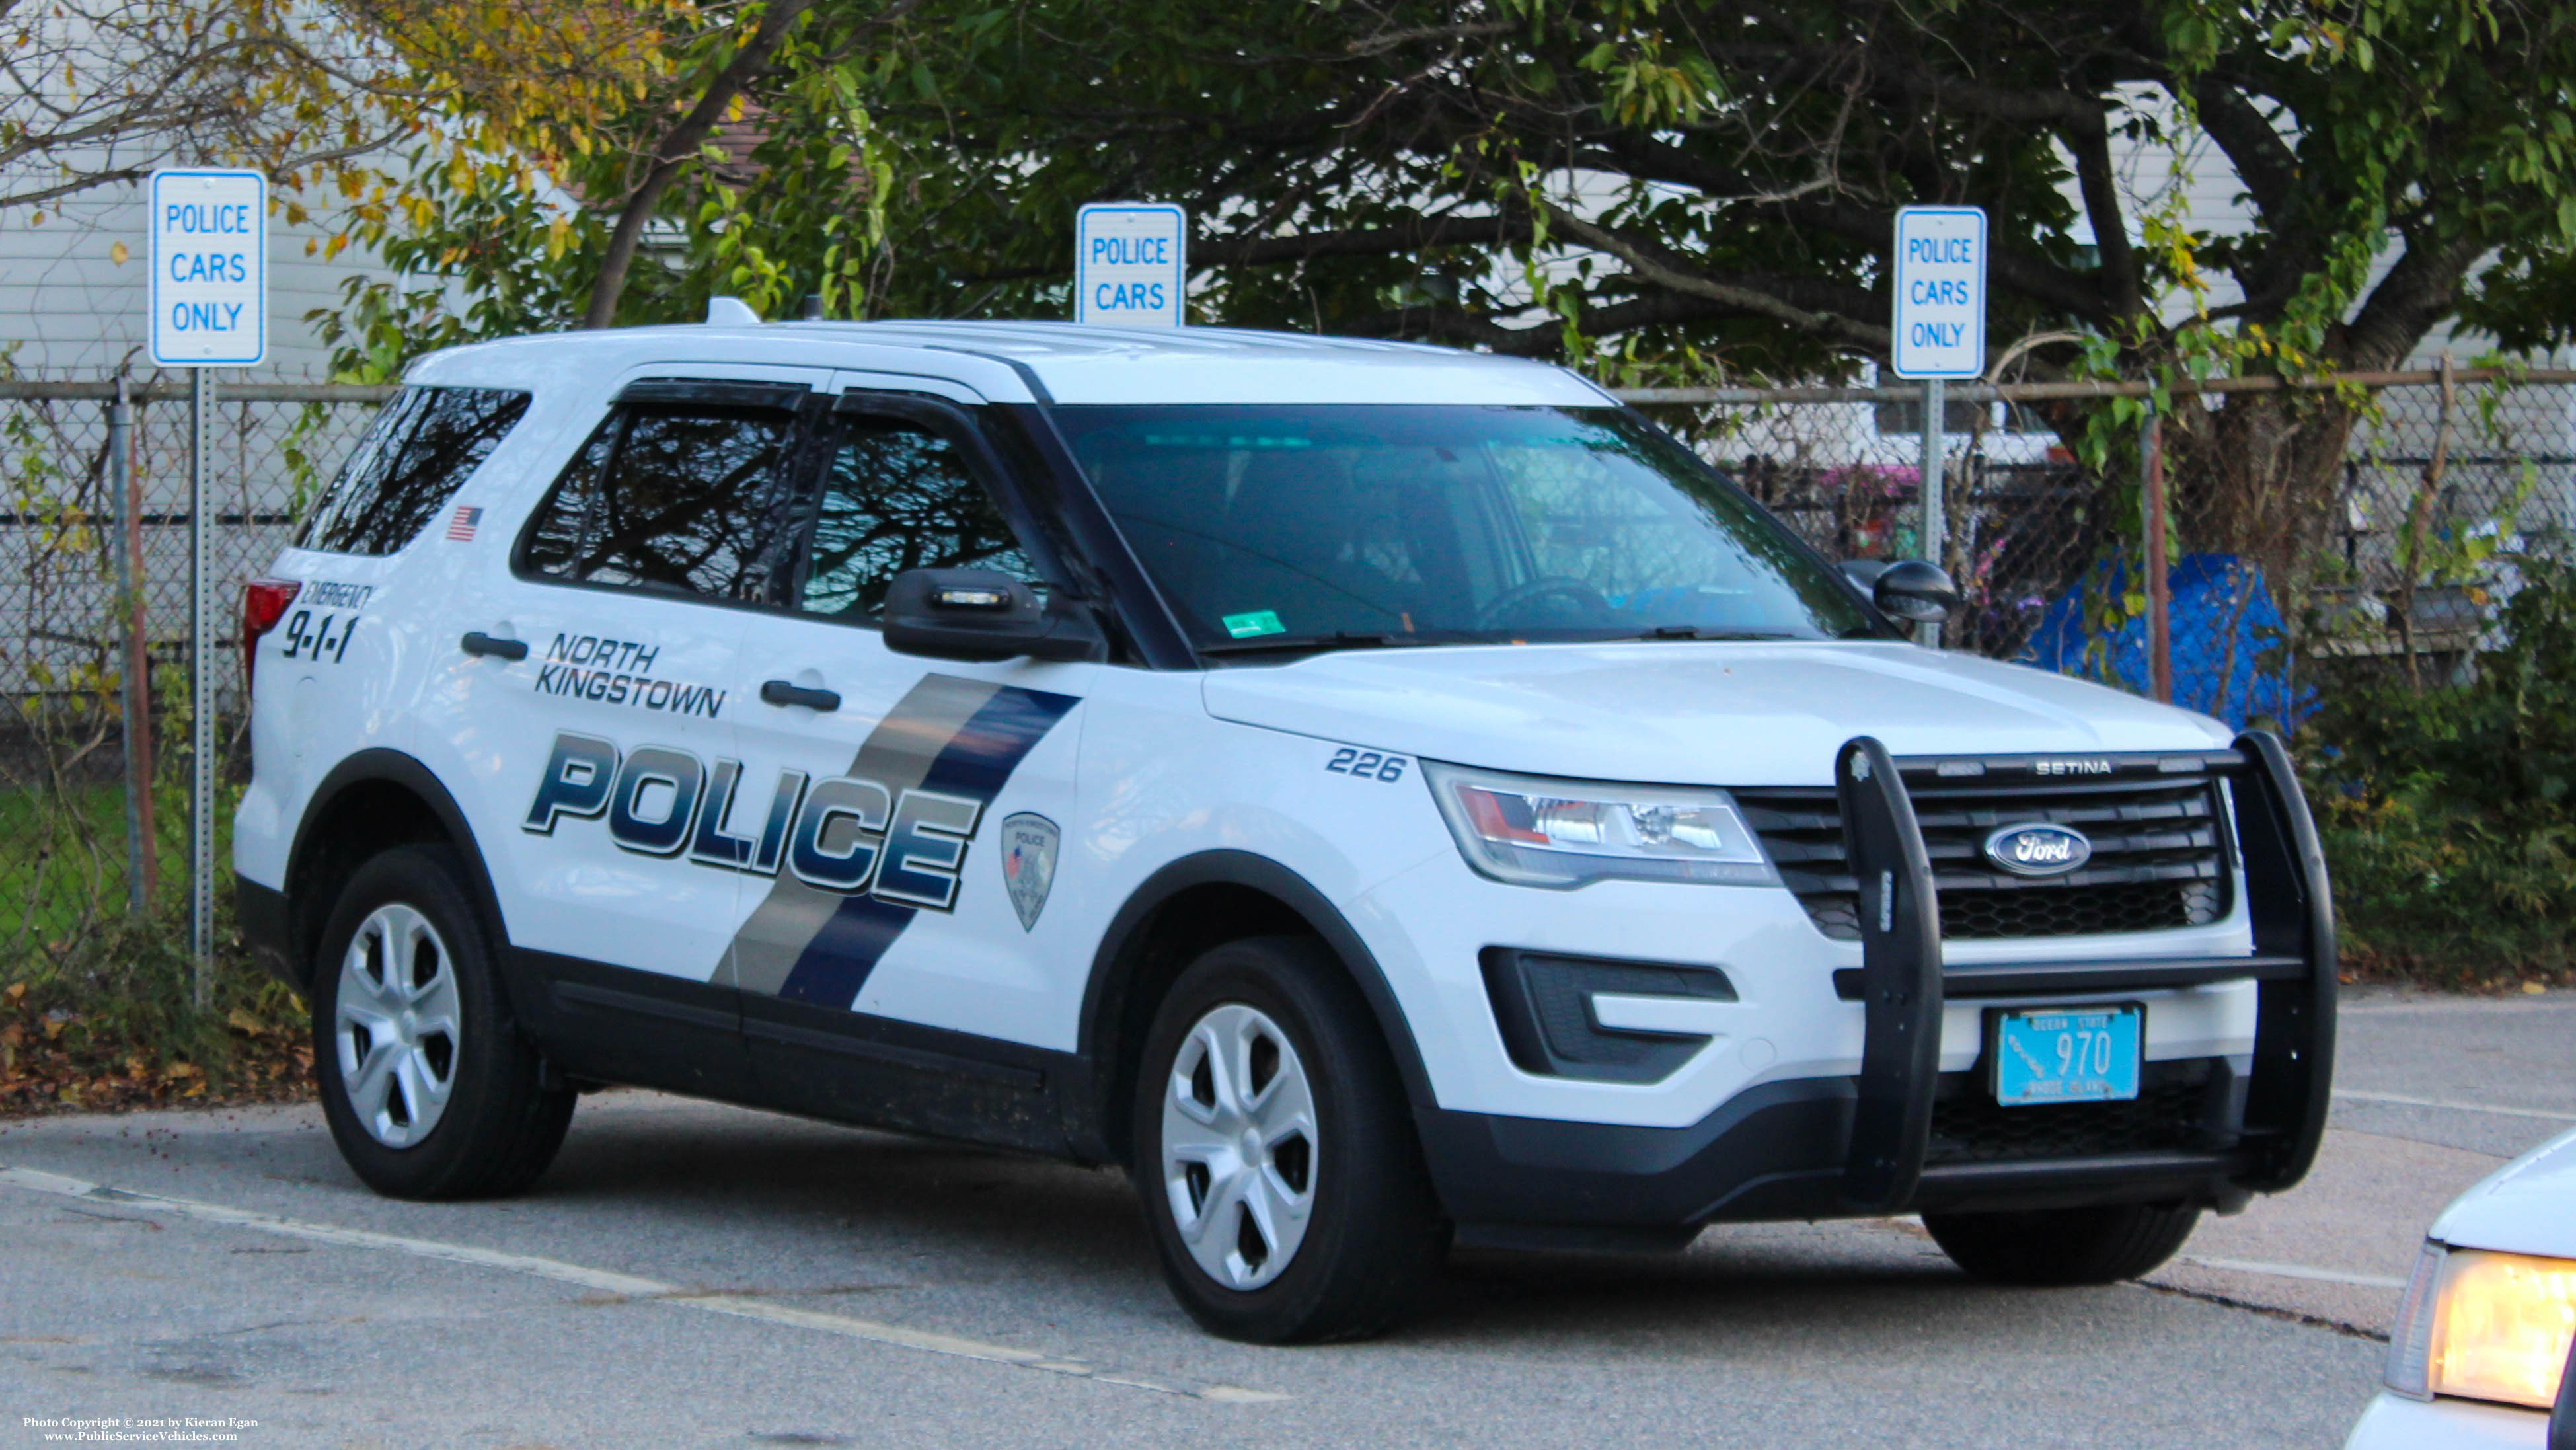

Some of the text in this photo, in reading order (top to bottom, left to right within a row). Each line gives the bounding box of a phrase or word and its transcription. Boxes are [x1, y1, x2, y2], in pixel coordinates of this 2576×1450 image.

[167, 204, 249, 233] POLICE
[1093, 238, 1168, 264] POLICE
[1909, 238, 1972, 264] POLICE
[171, 254, 245, 282] CARS
[1096, 283, 1164, 309] CARS
[1911, 280, 1968, 305] CARS
[173, 302, 243, 331] ONLY
[1911, 323, 1965, 347] ONLY
[300, 580, 373, 609] EMERGENCY
[282, 610, 360, 664] 9-1-1
[546, 633, 660, 673] NORTH
[535, 664, 726, 718] KINGSTOWN
[1325, 748, 1407, 783] 226
[2036, 761, 2112, 775] SETINA
[521, 728, 985, 913] POLICE
[1015, 831, 1045, 847] POLICE
[2016, 834, 2071, 862] Ford
[2056, 1031, 2111, 1076] 970
